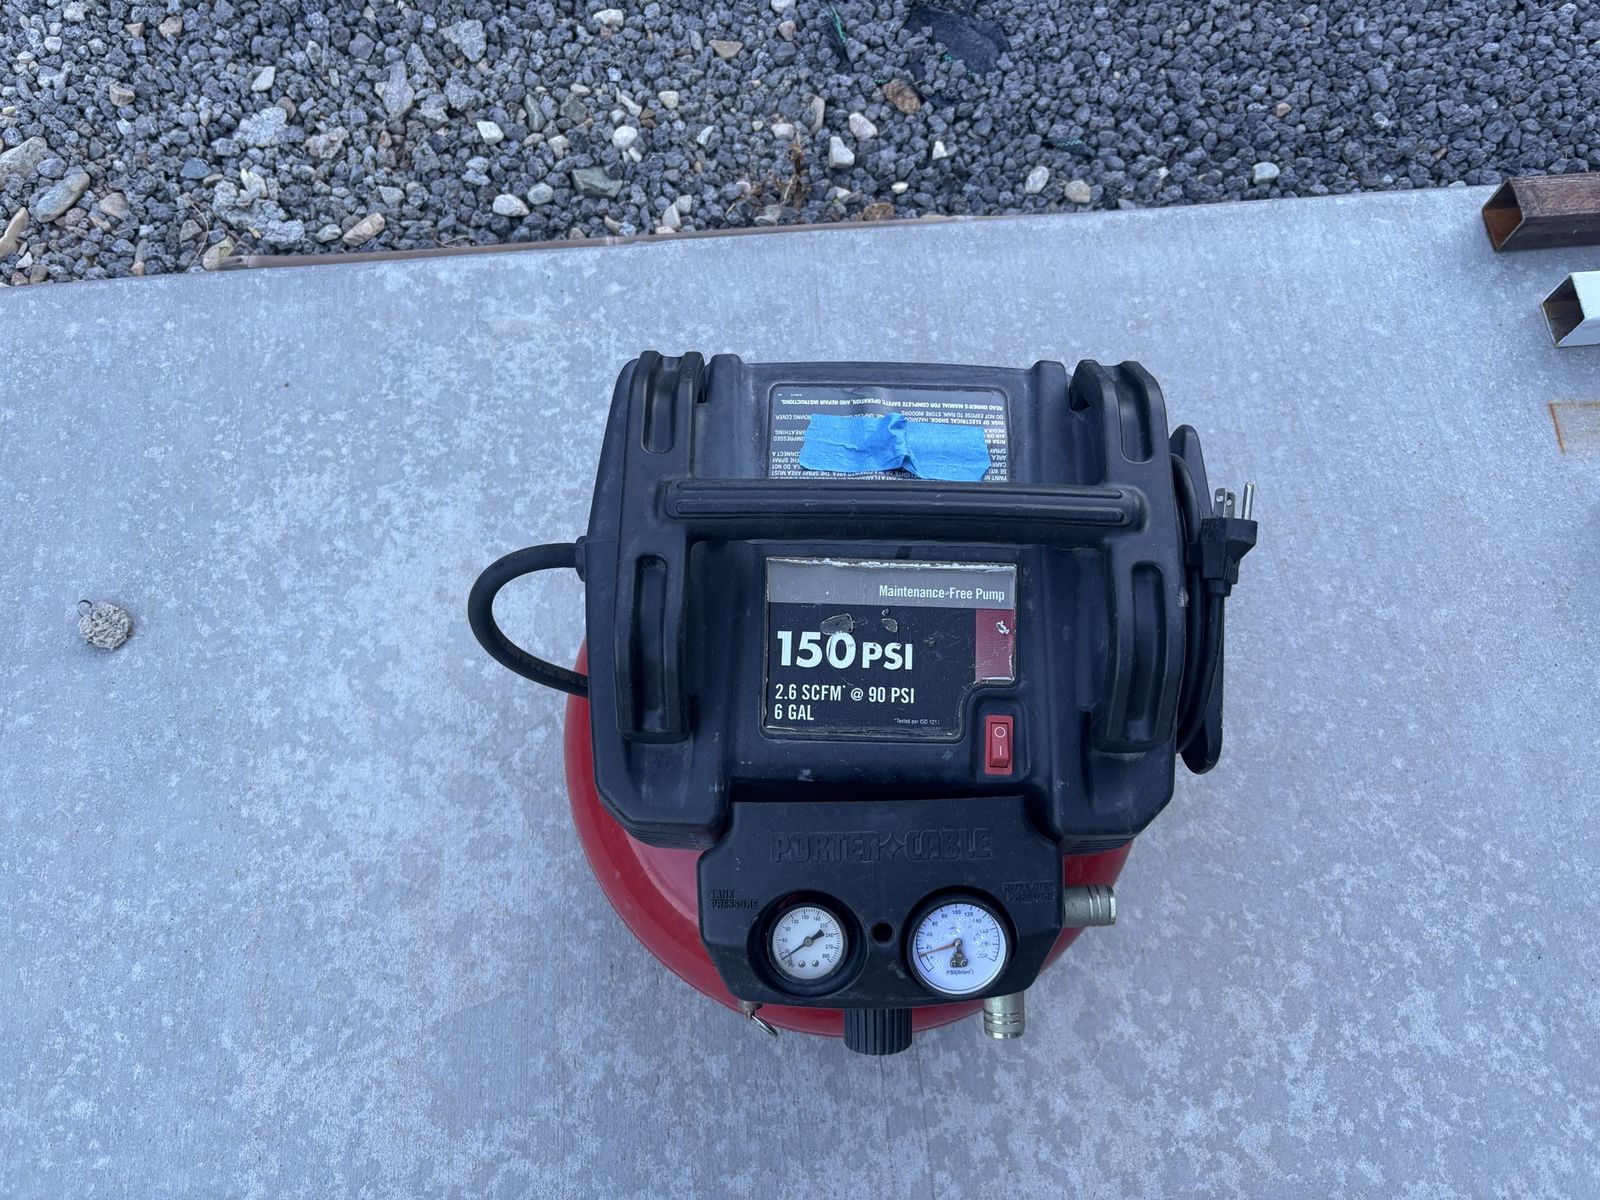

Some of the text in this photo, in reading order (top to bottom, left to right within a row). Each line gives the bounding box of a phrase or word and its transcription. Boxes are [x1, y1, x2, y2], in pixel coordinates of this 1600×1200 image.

[880, 585, 1004, 602] Maintenance-Free Pump
[777, 630, 913, 670] 150 PSI
[775, 684, 797, 700] 2.6
[850, 688, 864, 701] @
[868, 686, 886, 702] 90
[891, 688, 914, 704] PSI
[774, 704, 814, 721] 6 GAL
[770, 828, 991, 864] PORTER CABLE
[710, 899, 759, 911] PRESSURE
